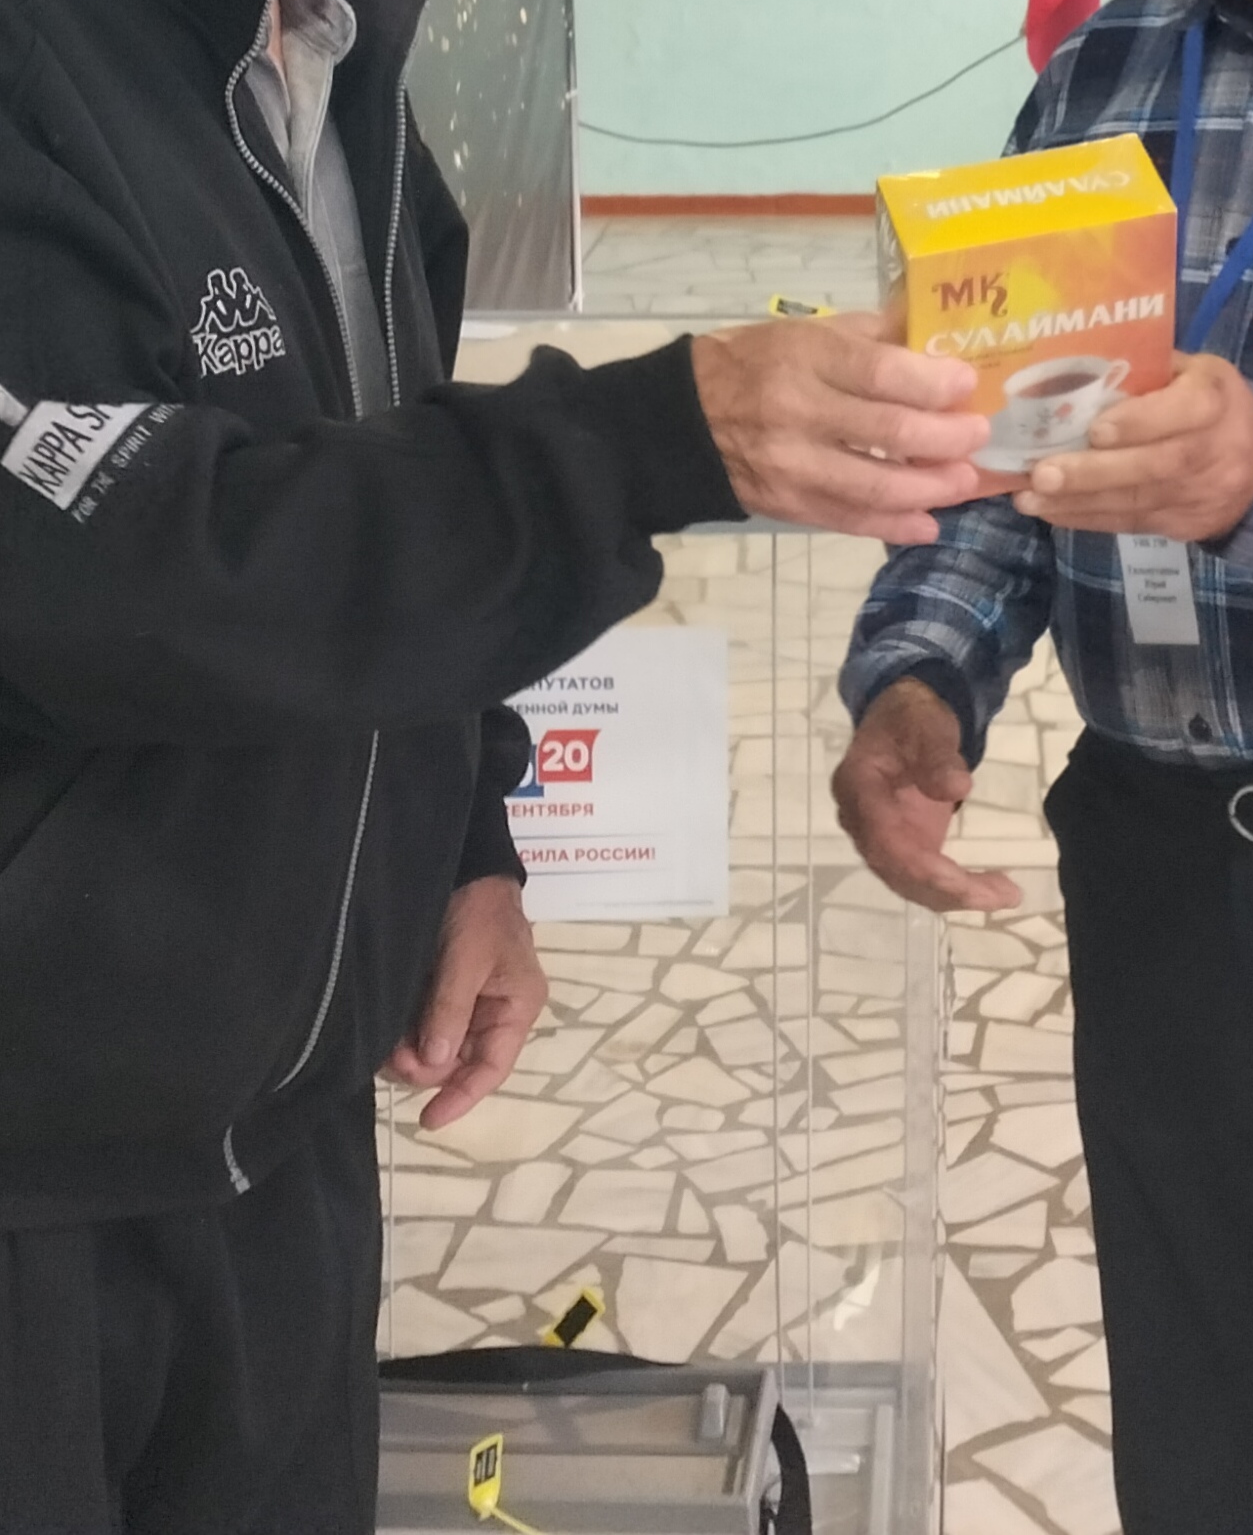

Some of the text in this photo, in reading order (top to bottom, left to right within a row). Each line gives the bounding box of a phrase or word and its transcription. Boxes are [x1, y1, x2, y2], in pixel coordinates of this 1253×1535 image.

[926, 170, 1131, 219] СУЛАЙМАНИ
[925, 293, 1165, 357] СУЛАЙМАНИ
[191, 326, 286, 378] Kappa
[18, 421, 93, 496] KAPPA
[110, 425, 152, 467] SPIRIT
[511, 700, 619, 716] ЕННОЙ ДУМЫ
[541, 740, 590, 772] 20
[519, 847, 656, 863] СИЛА РОССИИ!
